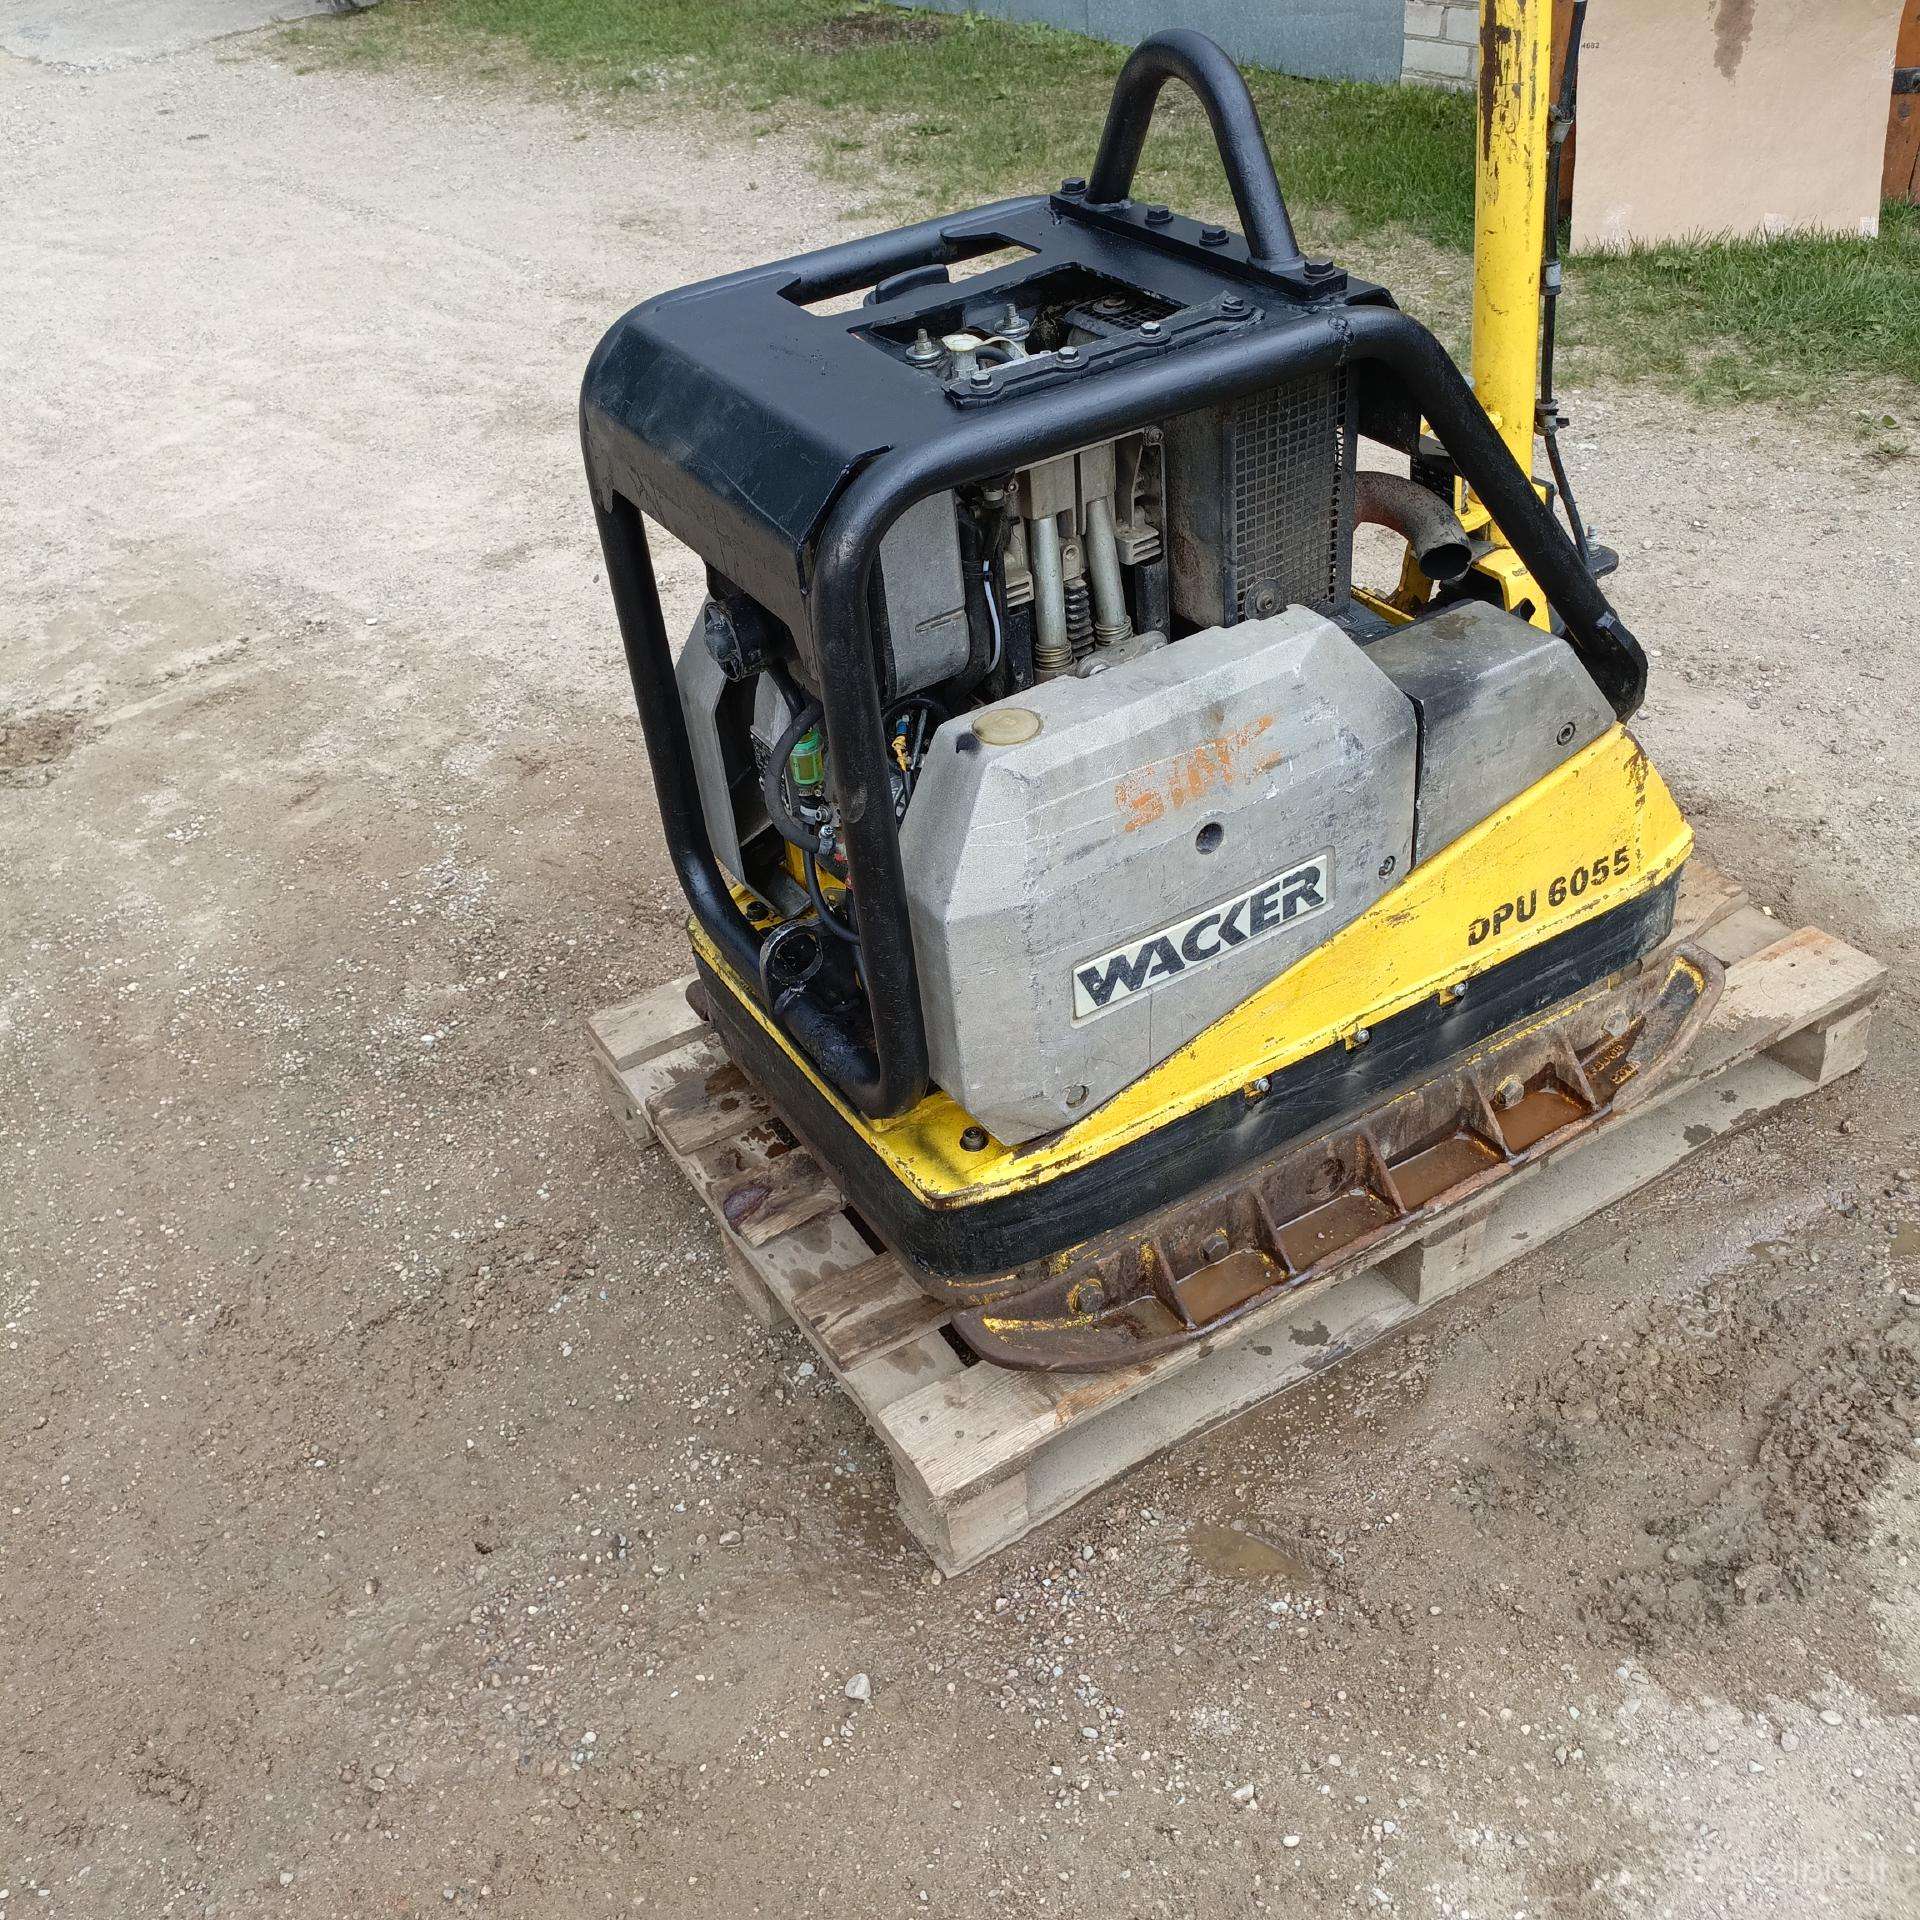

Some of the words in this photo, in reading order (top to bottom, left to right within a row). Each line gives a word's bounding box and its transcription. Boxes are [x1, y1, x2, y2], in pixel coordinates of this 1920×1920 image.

[1077, 866, 1324, 1007] WACKER
[1467, 888, 1537, 947] DPU
[1548, 845, 1631, 907] 6055
